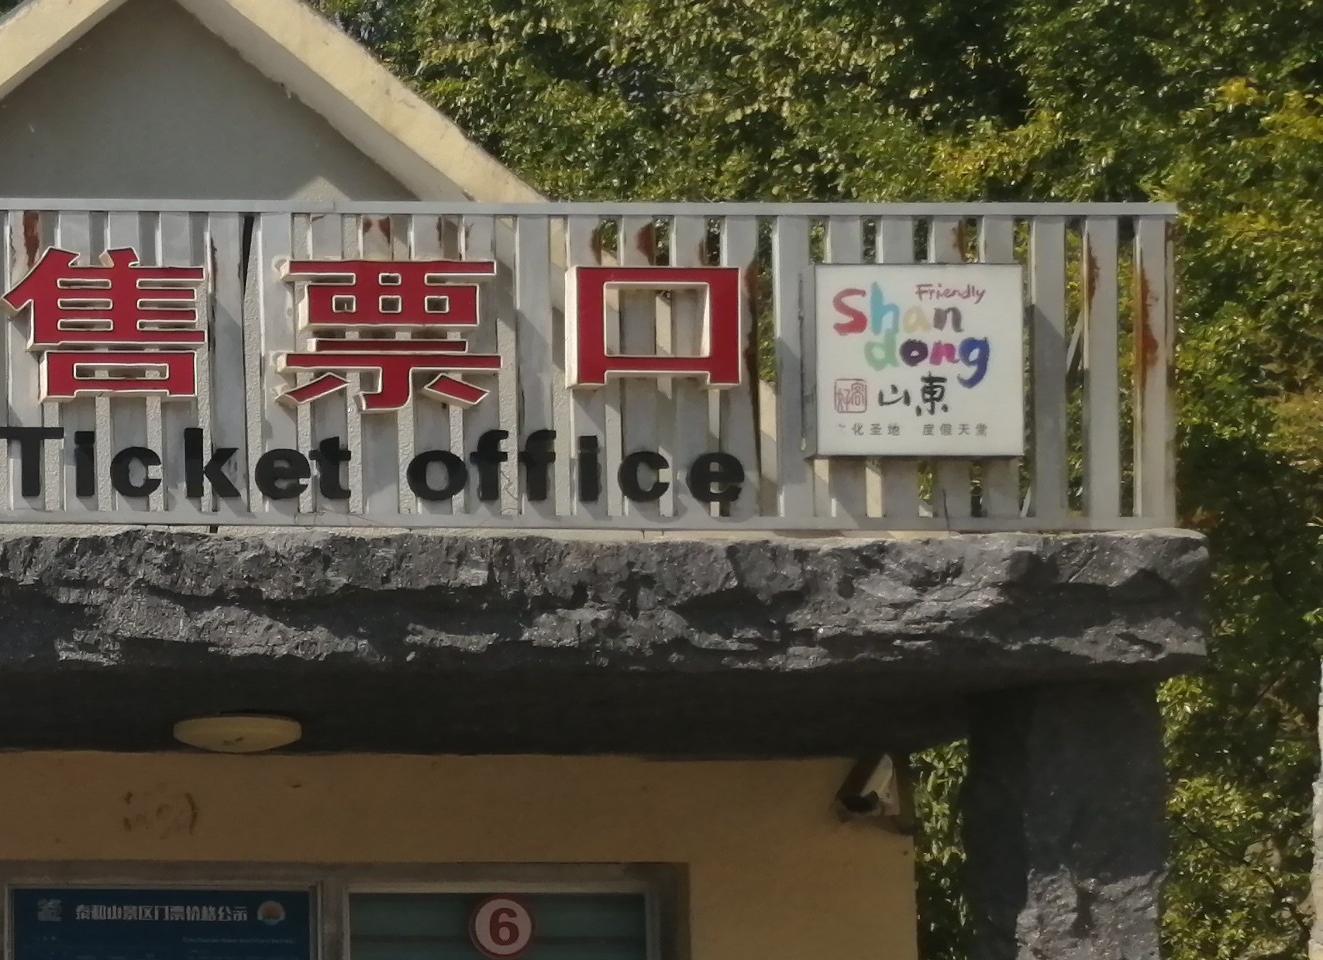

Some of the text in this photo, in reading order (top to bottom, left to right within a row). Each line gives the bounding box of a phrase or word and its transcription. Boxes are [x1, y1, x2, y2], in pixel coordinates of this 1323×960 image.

[832, 281, 964, 335] Shan
[915, 283, 986, 304] Friendly
[863, 329, 990, 389] dong
[838, 423, 988, 436] 化圣地 度假天堂
[406, 429, 748, 503] office
[489, 907, 520, 947] 6
